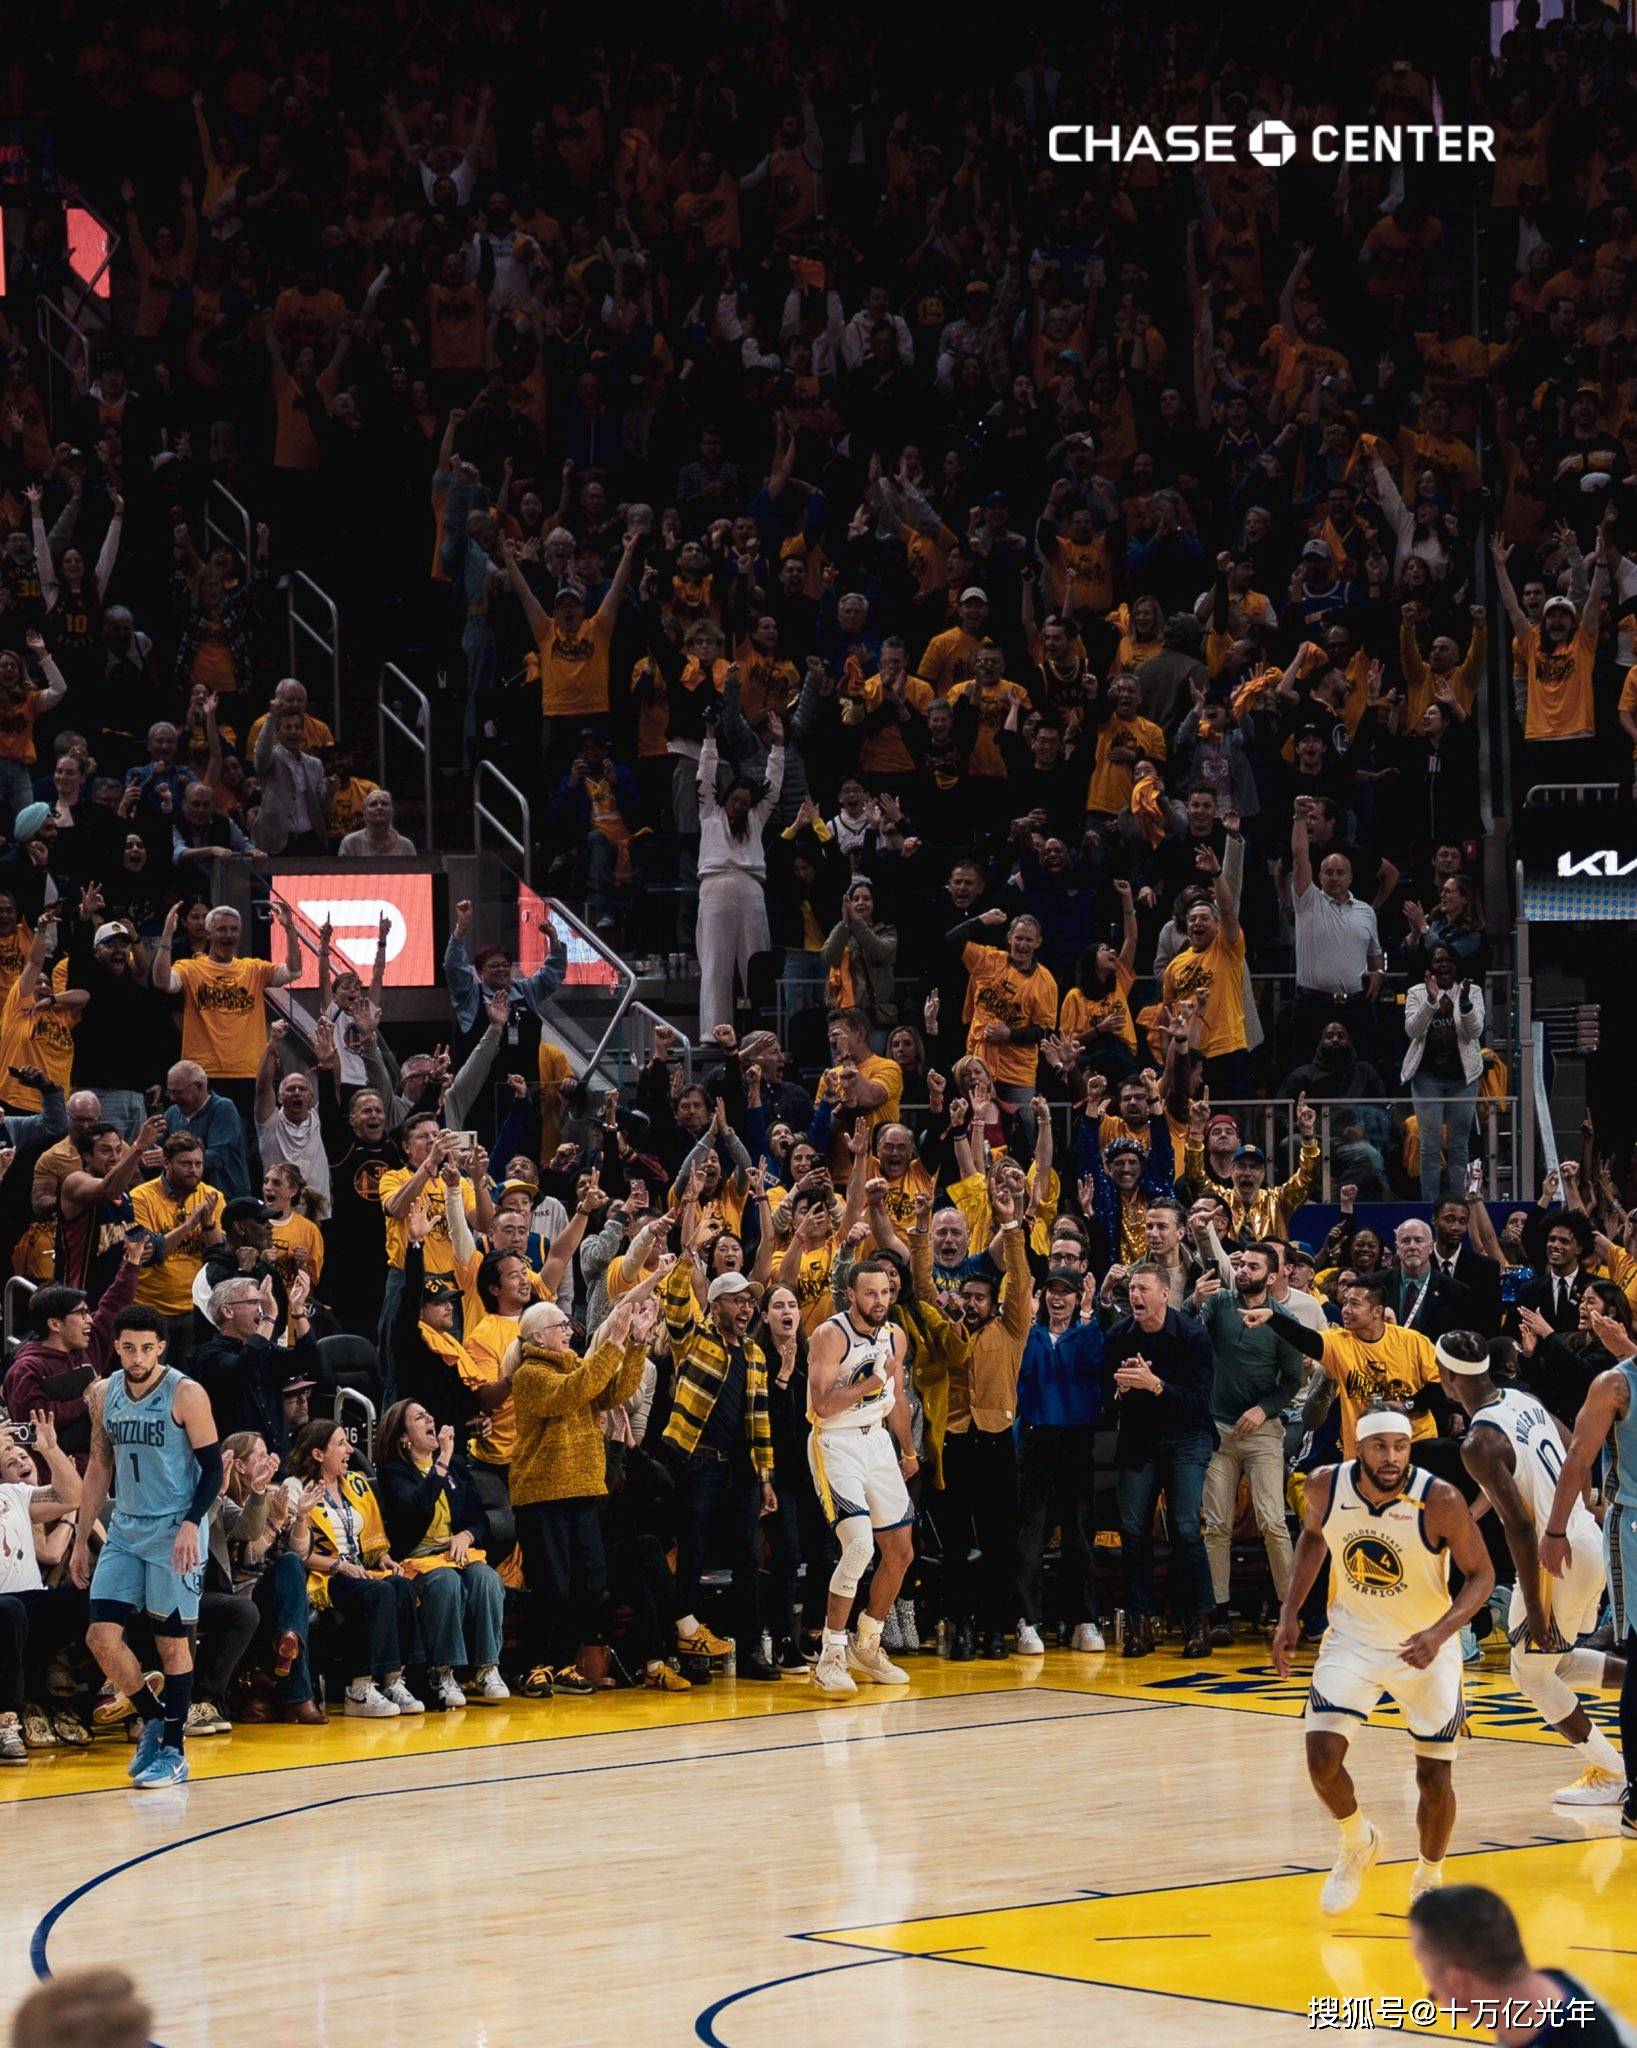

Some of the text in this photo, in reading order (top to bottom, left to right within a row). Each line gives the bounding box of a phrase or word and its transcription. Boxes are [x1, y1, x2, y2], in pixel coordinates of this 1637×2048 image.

[65, 613, 88, 634] 10
[107, 1419, 165, 1447] GRIZZLIES
[129, 1452, 140, 1483] 1
[1342, 1529, 1403, 1553] GOLDEN STATE
